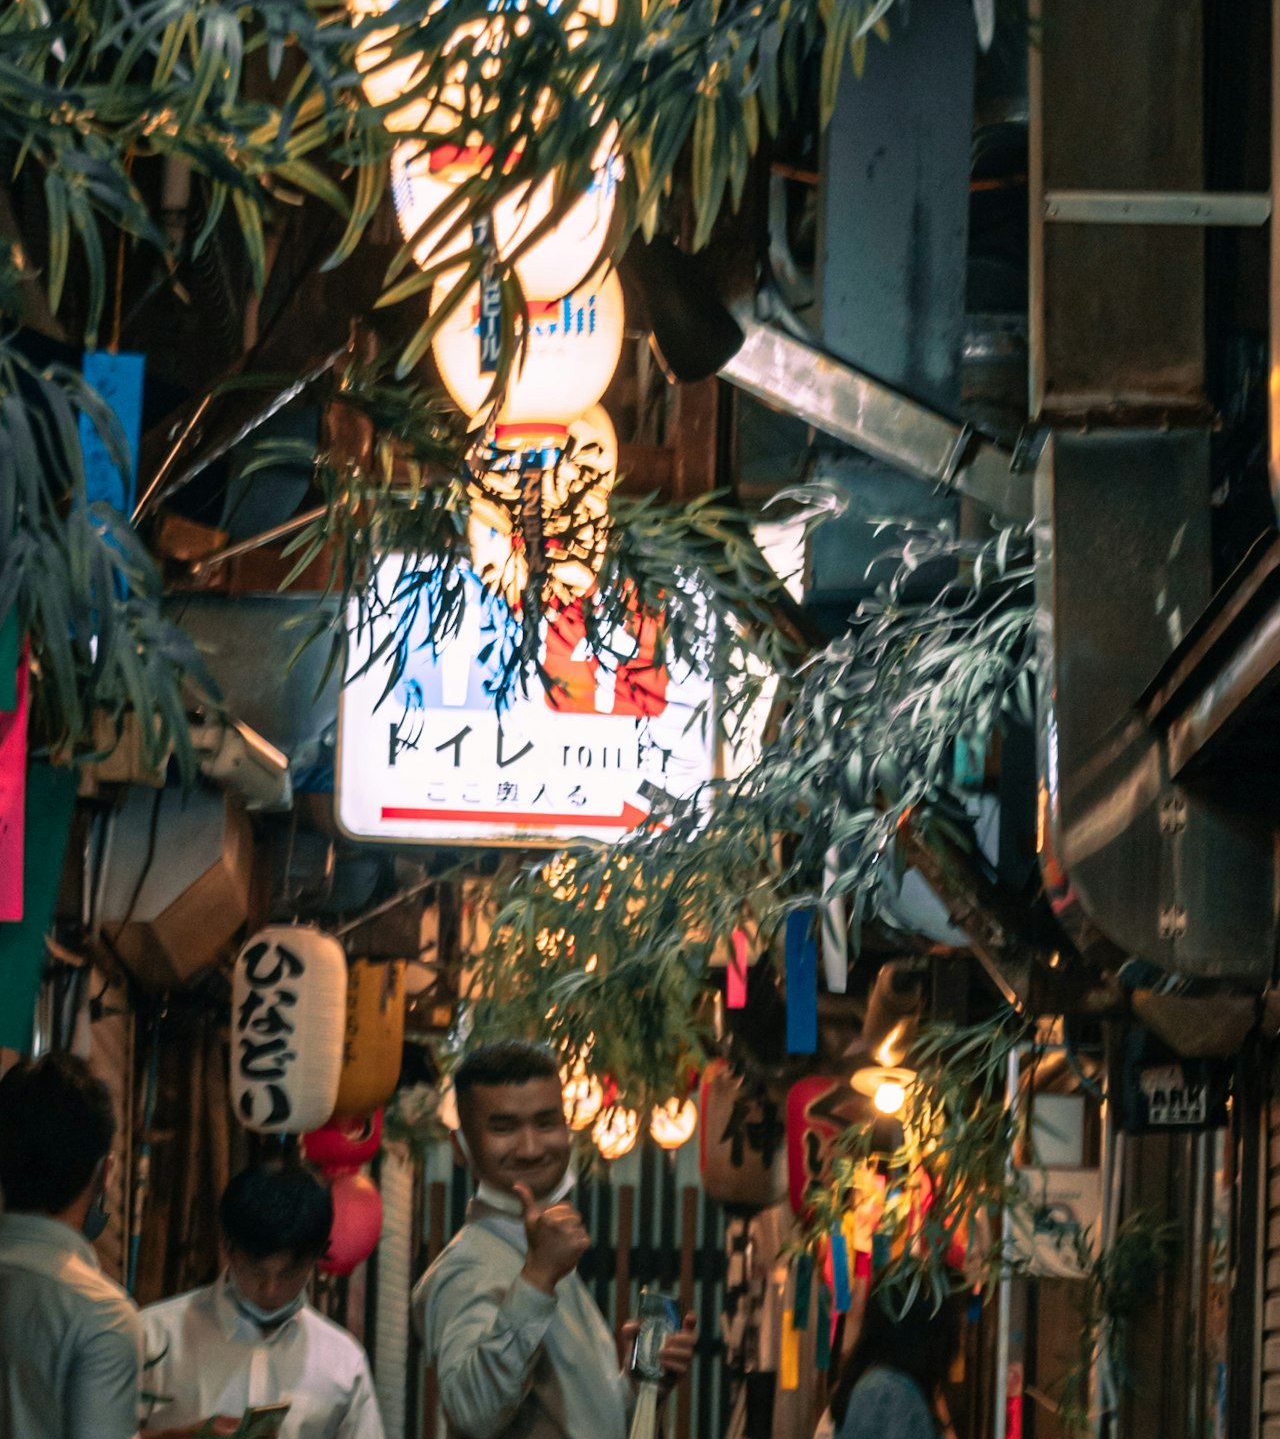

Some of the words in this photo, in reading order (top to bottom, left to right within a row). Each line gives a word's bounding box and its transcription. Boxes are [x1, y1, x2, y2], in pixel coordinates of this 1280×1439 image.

[388, 722, 534, 768] トイレ
[426, 780, 588, 807] ここ奥入る
